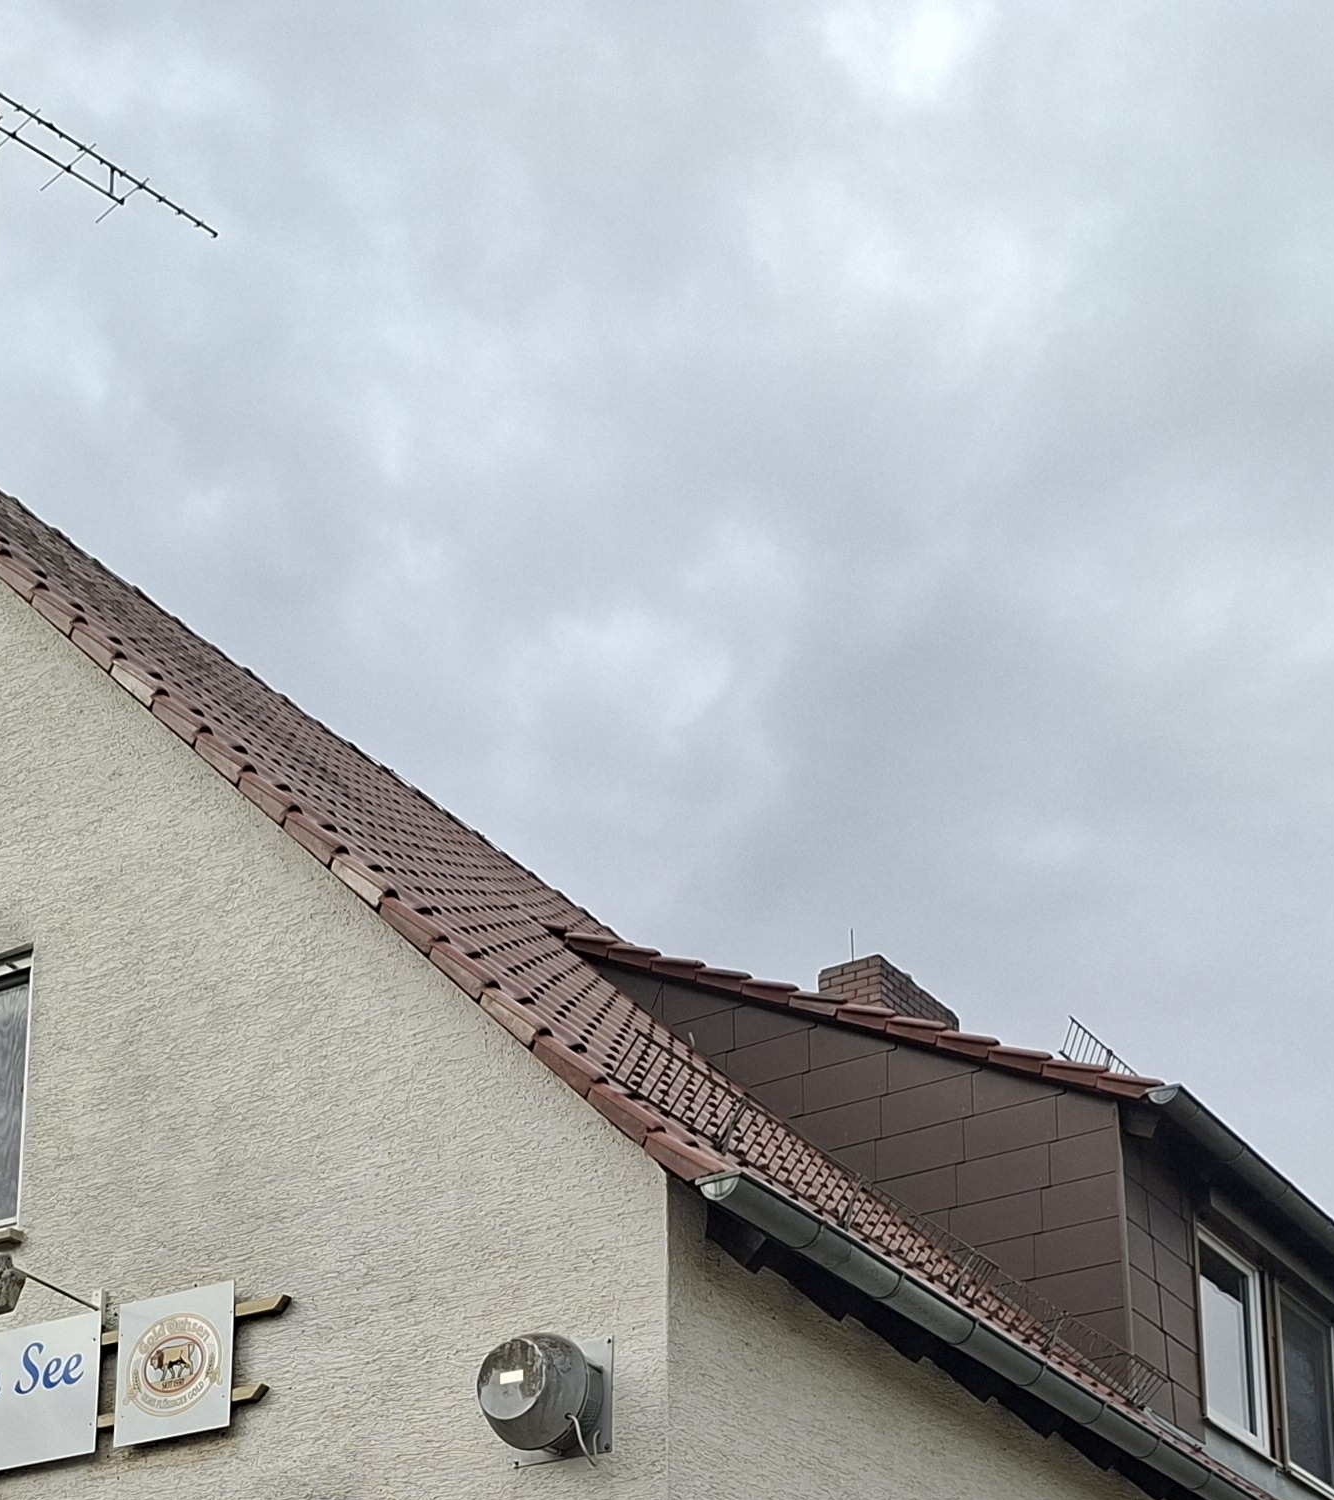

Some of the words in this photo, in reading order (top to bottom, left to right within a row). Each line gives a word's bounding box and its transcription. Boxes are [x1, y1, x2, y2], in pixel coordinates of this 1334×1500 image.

[138, 1323, 166, 1355] Gold
[167, 1318, 211, 1343] Ochsen
[14, 1341, 84, 1395] See
